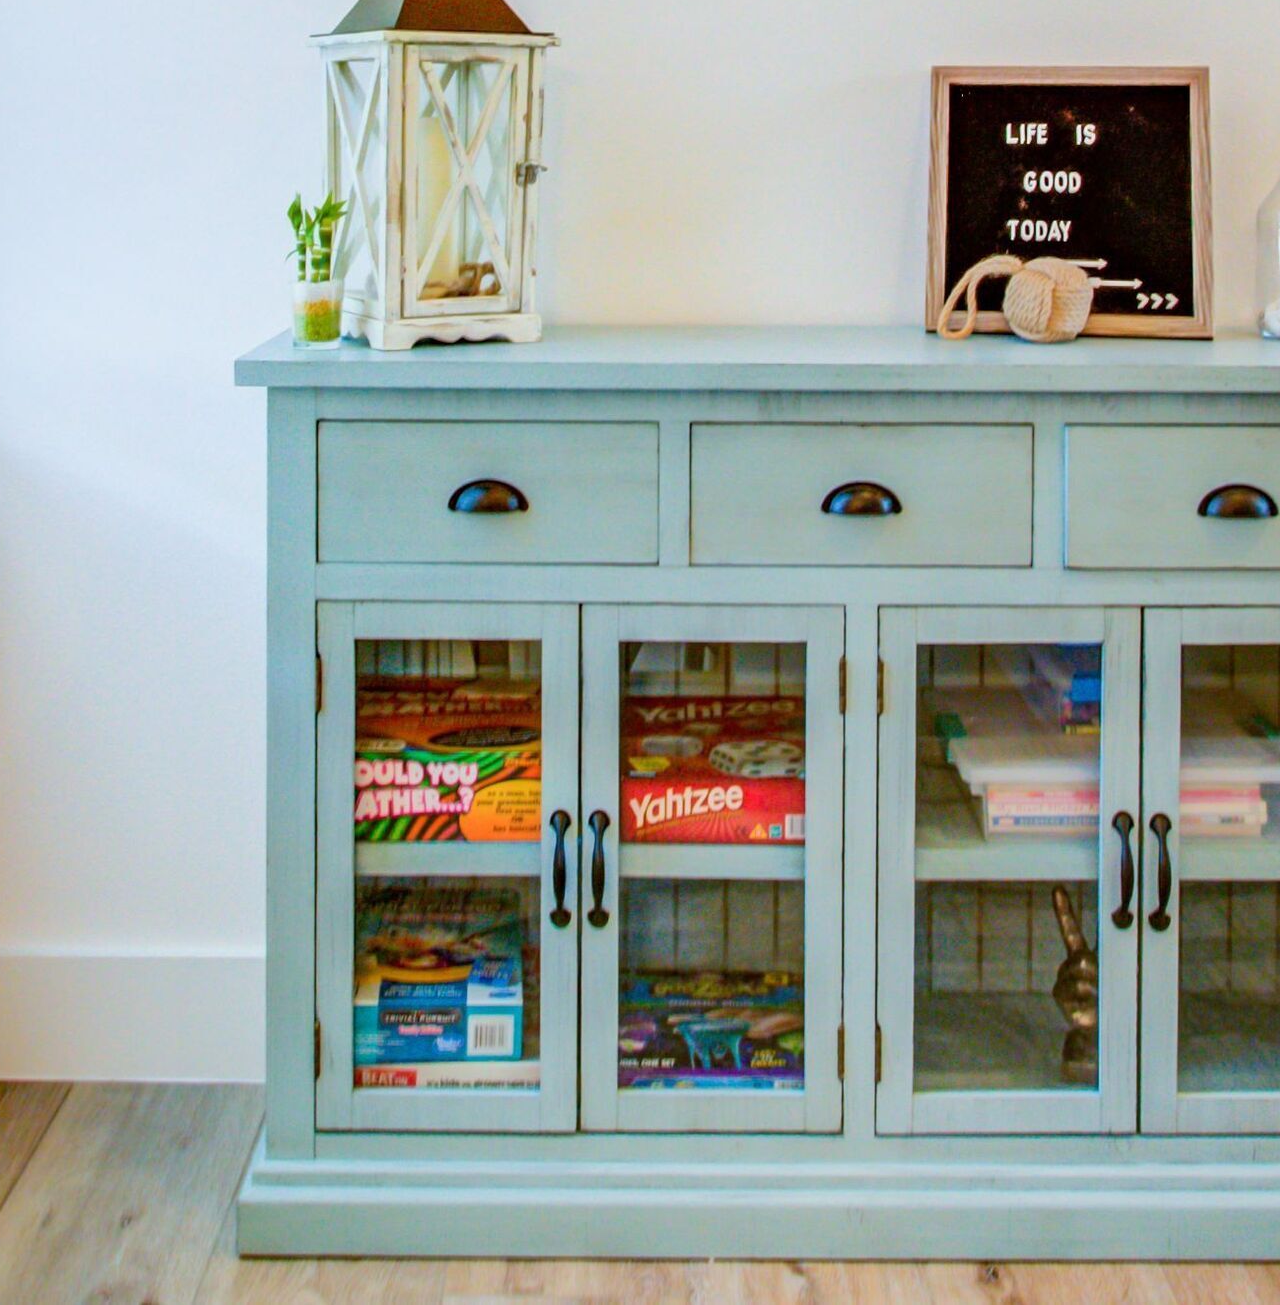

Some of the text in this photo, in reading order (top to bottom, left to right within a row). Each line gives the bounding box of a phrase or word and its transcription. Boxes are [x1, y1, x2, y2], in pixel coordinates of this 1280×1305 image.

[1005, 122, 1097, 145] LIFE IS
[1022, 170, 1082, 194] GOOD
[1006, 220, 1072, 242] TODAY
[355, 758, 478, 787] OULD YOU
[629, 785, 744, 829] Yahtzee
